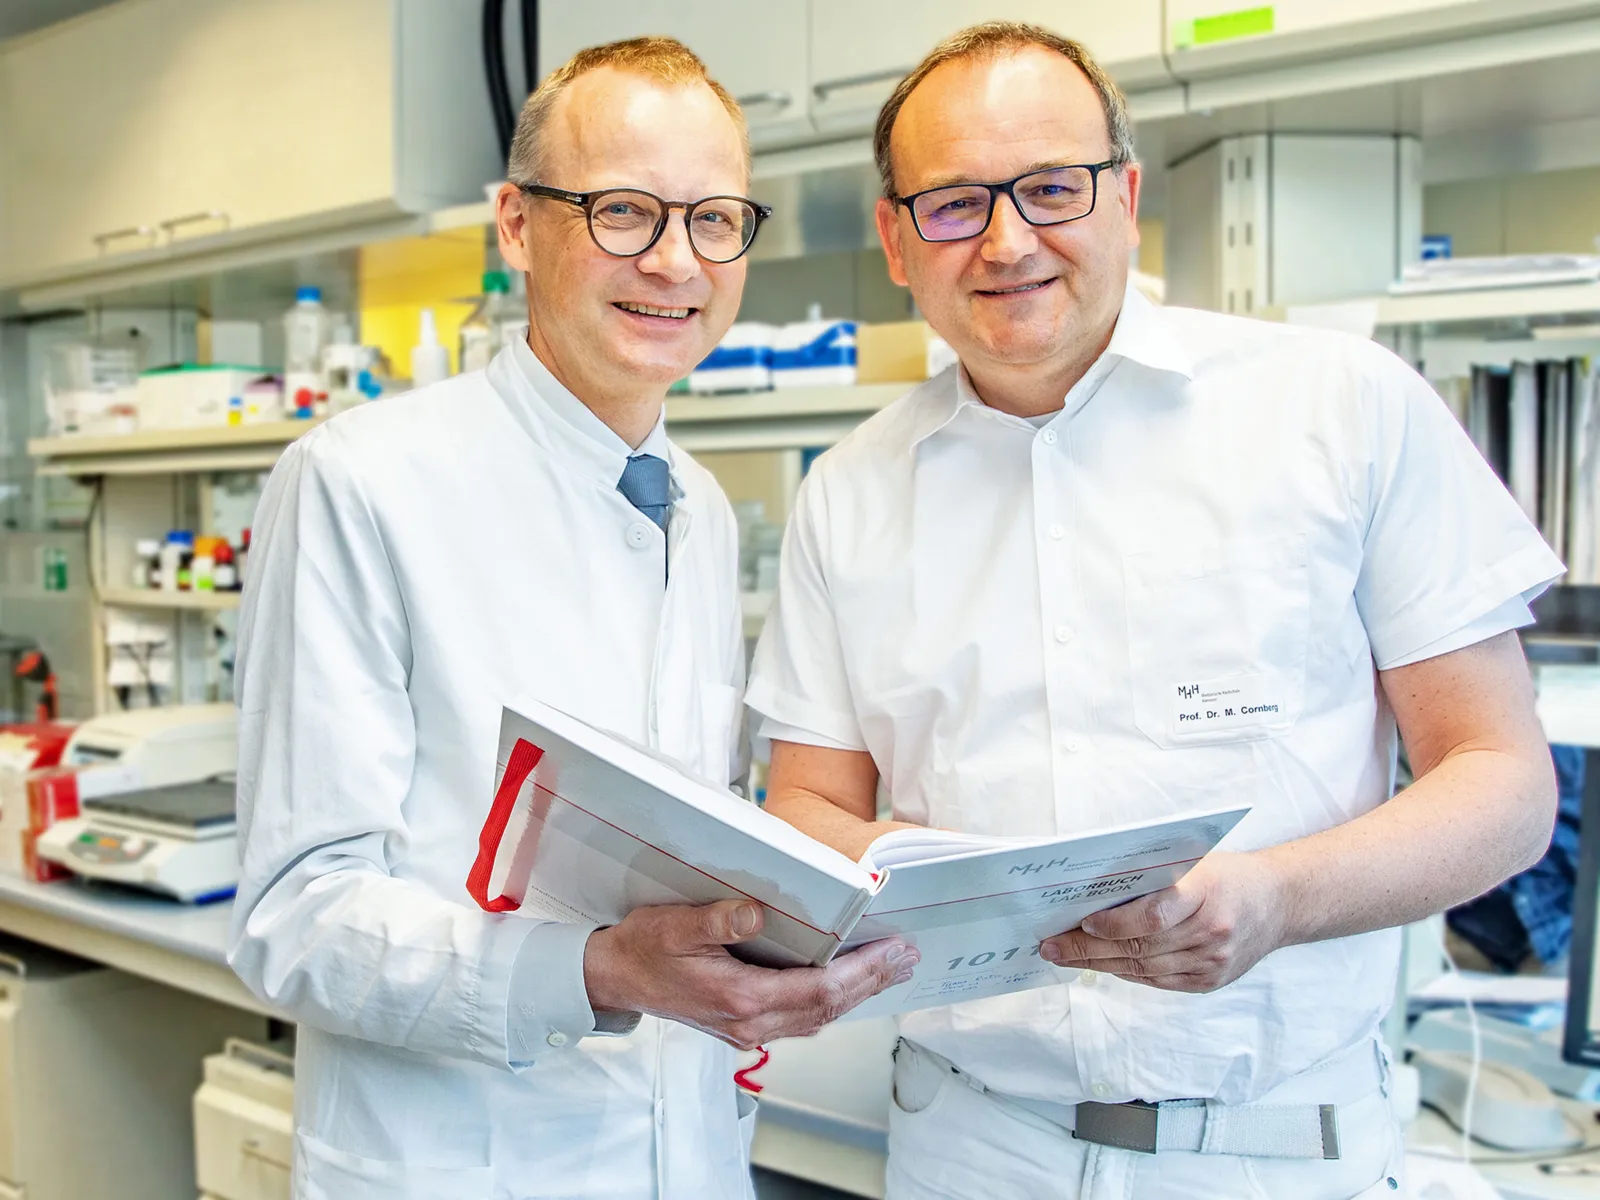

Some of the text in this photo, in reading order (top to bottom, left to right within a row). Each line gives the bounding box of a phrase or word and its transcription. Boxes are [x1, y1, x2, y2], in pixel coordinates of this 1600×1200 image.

[1178, 684, 1200, 700] MHH
[1180, 704, 1279, 721] Prof. Dr. M. Cornberg
[1008, 857, 1069, 876] MHH
[1041, 874, 1144, 898] LABORBUCH
[1049, 883, 1136, 904] LAB BOOK
